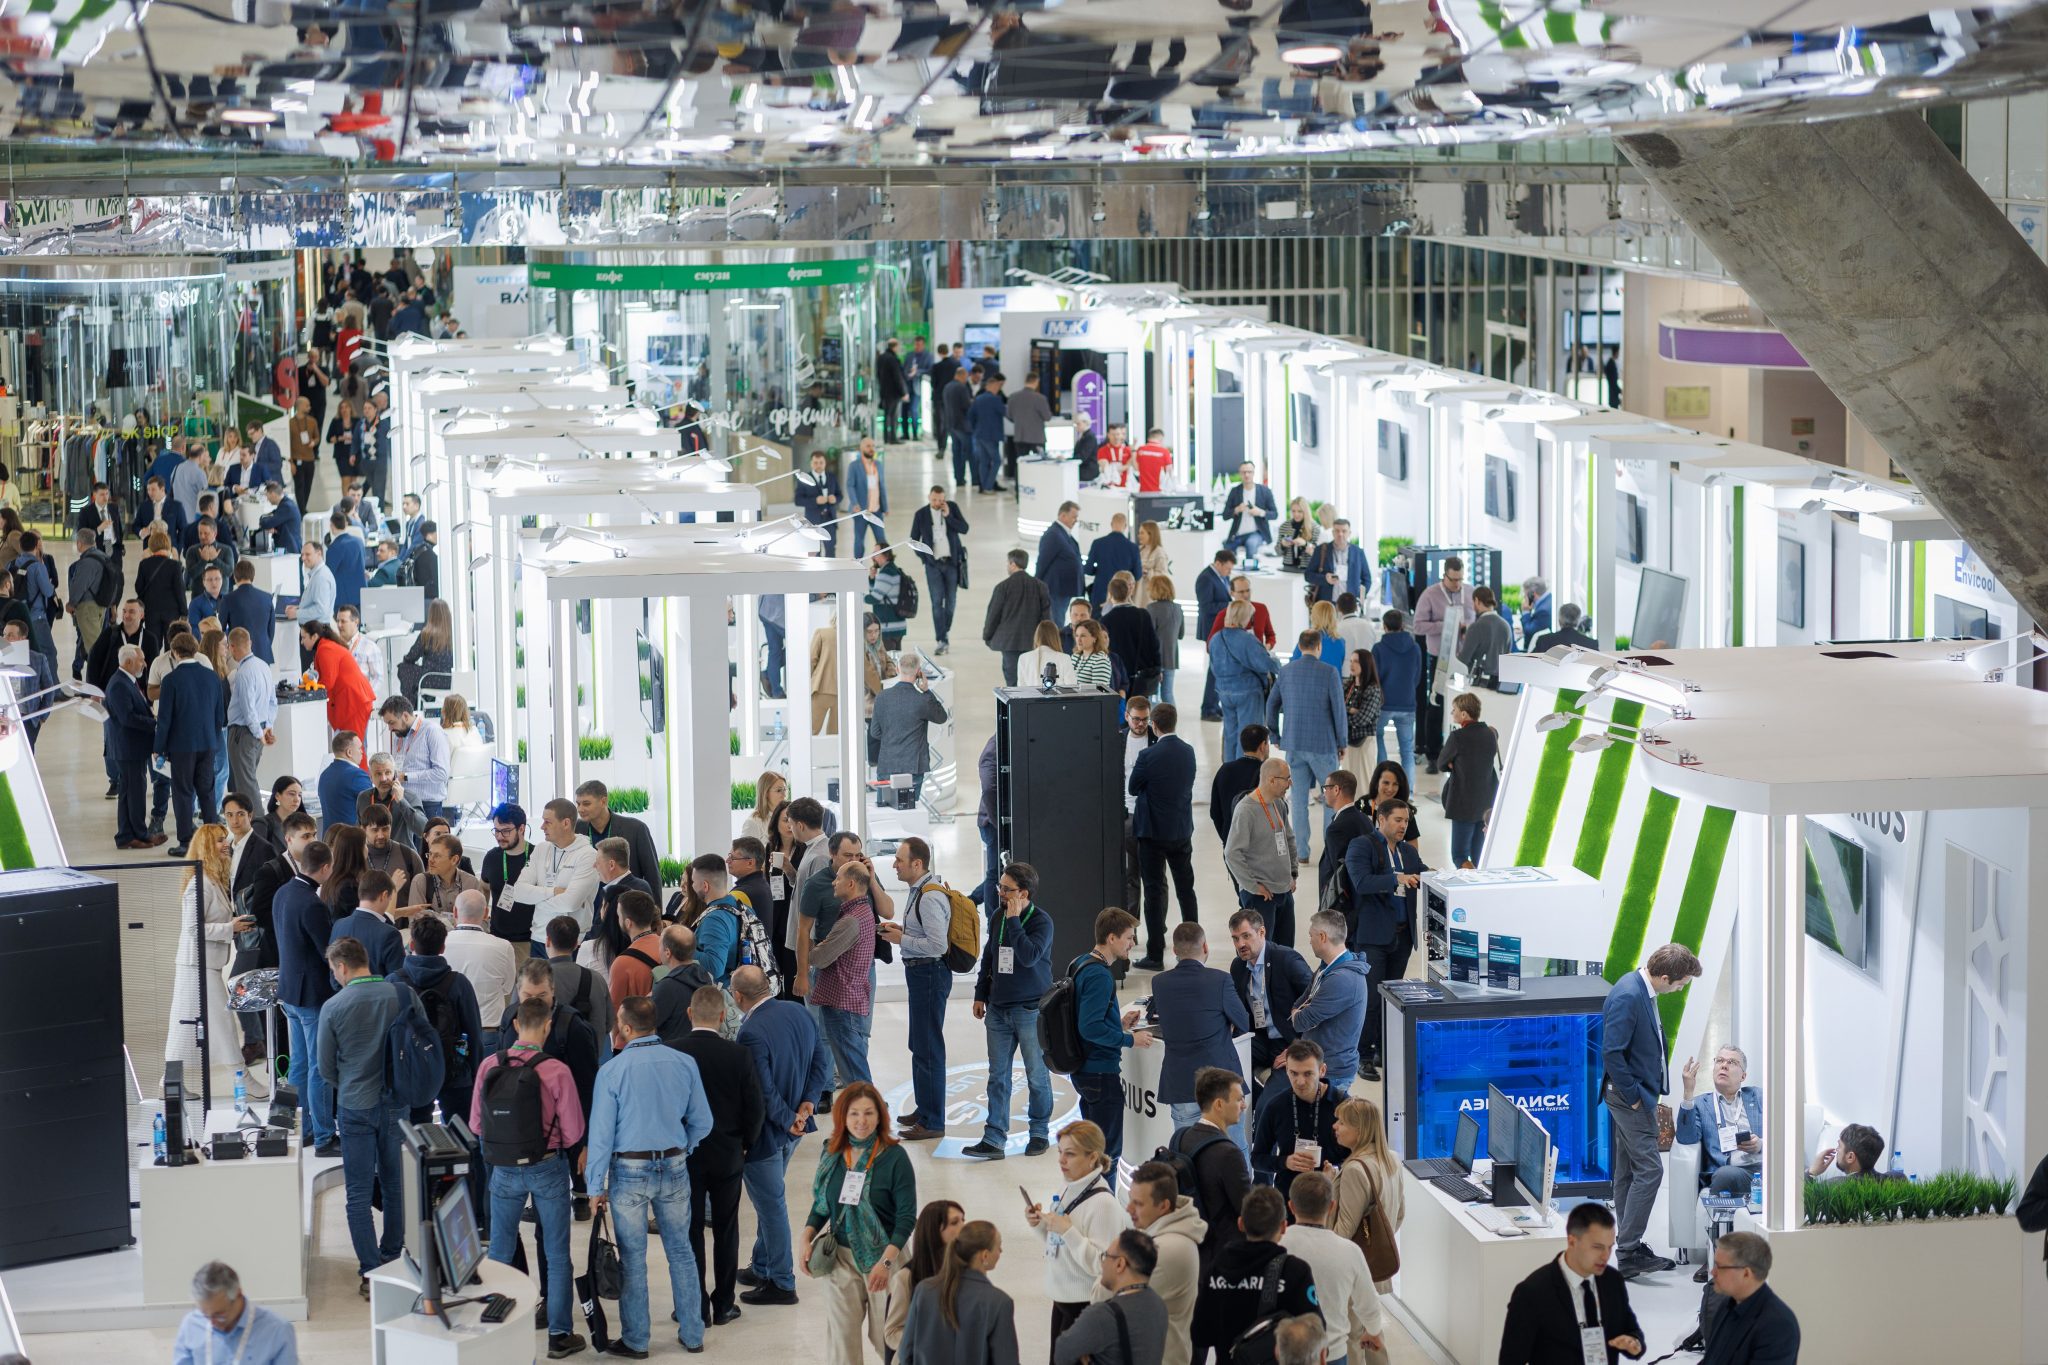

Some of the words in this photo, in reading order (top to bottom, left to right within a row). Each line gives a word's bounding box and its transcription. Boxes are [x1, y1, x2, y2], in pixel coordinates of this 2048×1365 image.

[595, 269, 624, 285] кофе
[693, 271, 731, 284] смузи
[786, 266, 823, 282] фреши
[121, 426, 141, 440] SK
[143, 424, 179, 440] SHOP
[1954, 556, 1997, 593] Envicool
[1458, 1094, 1570, 1112] АЭДИСК
[1208, 1274, 1287, 1293] AQARIS
